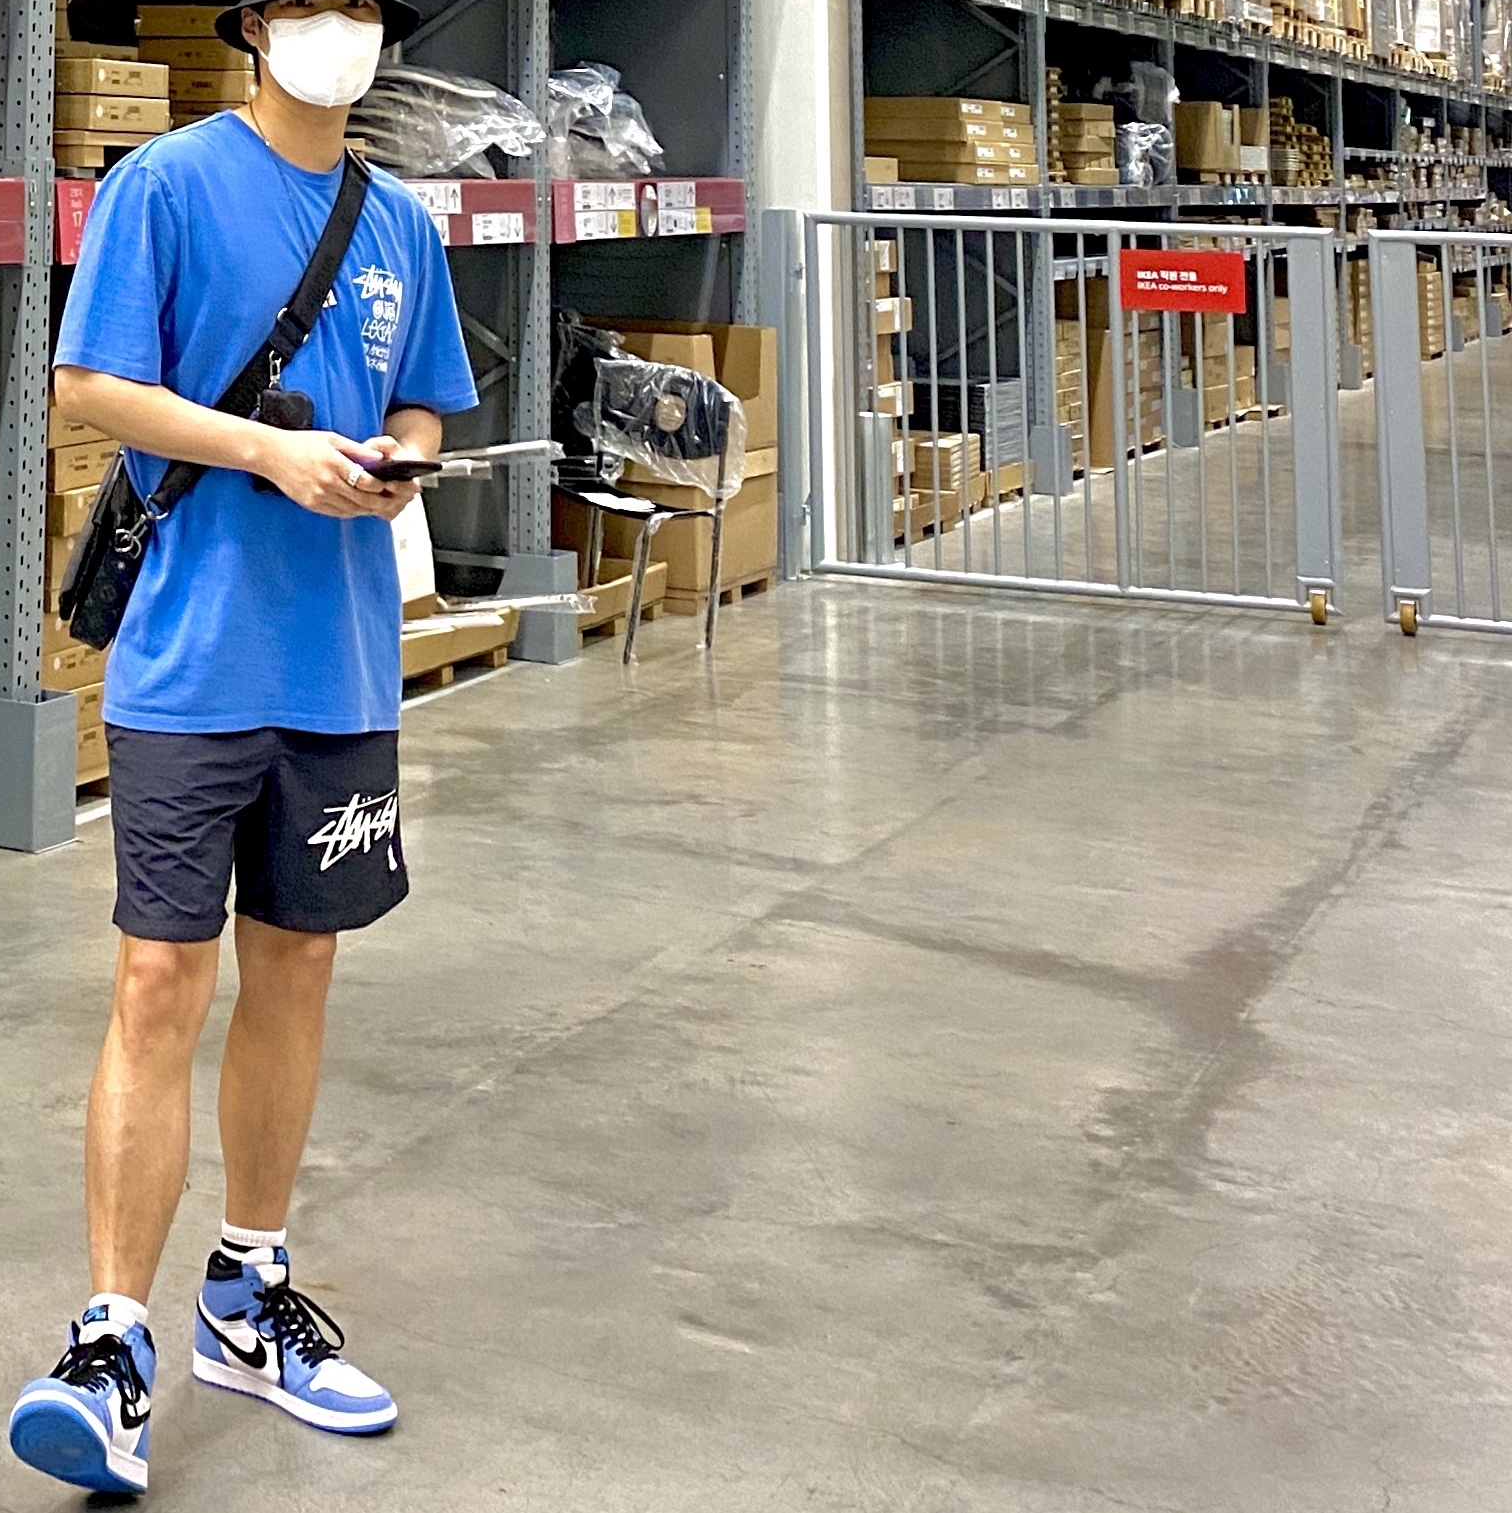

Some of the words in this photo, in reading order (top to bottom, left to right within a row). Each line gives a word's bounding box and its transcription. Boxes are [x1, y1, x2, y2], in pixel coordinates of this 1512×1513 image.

[72, 210, 83, 227] 17
[1137, 282, 1157, 290] IKEA
[1158, 283, 1207, 292] co-workers
[1208, 285, 1228, 295] only
